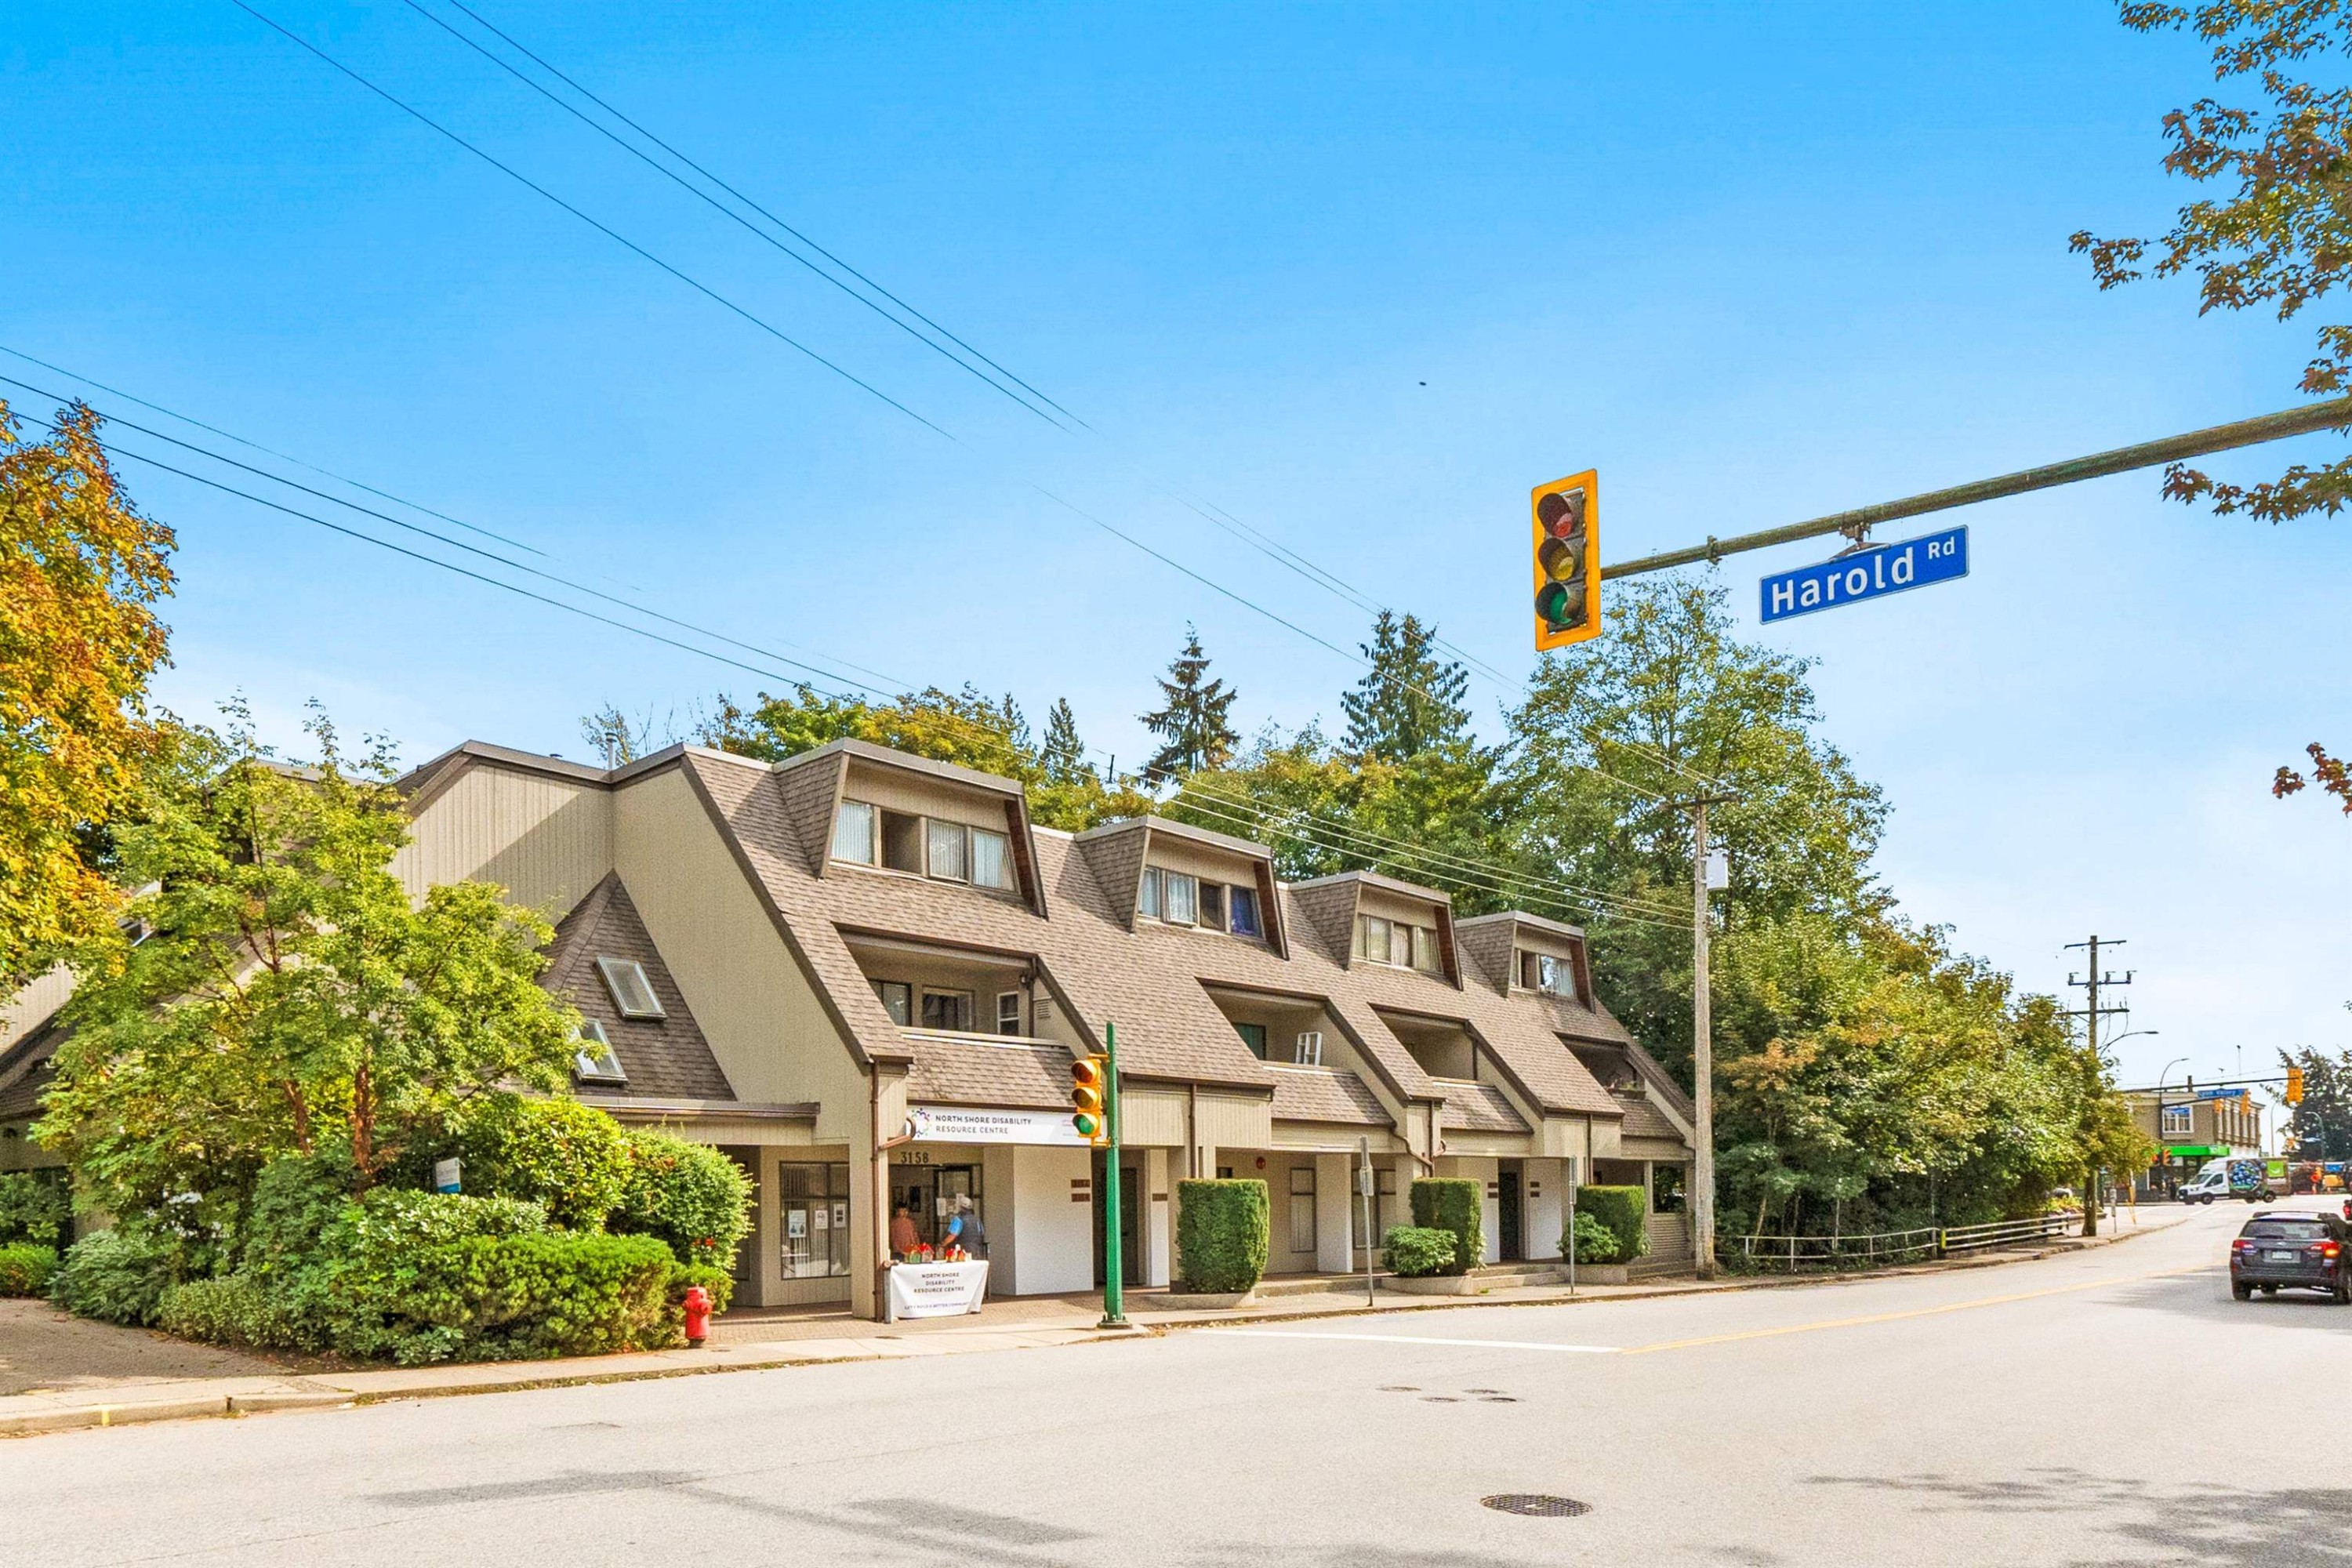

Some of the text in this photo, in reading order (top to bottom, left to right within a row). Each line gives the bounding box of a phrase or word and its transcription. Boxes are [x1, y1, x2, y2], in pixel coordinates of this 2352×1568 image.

[1772, 536, 1955, 614] Harold Rd
[901, 1152, 929, 1163] 3158
